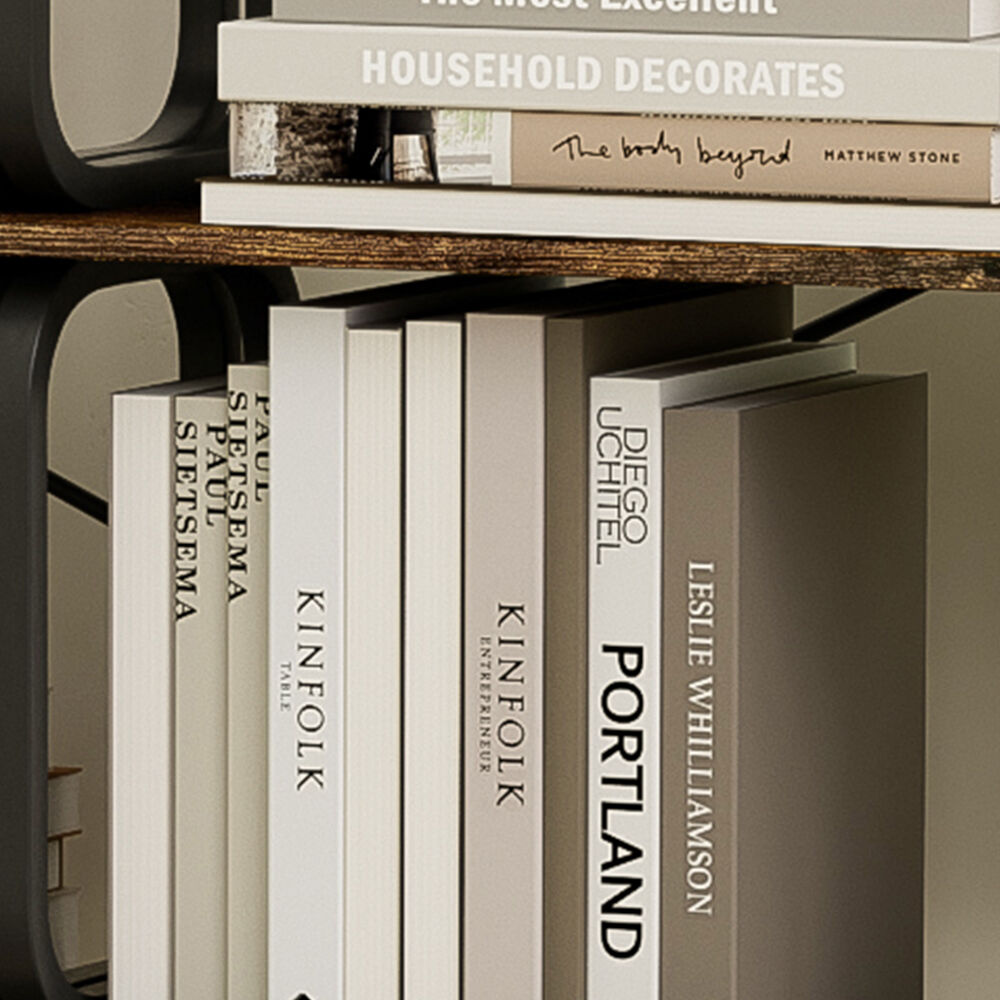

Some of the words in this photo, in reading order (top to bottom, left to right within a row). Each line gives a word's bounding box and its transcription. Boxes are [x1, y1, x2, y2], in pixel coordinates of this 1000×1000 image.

[361, 50, 602, 91] HOUSEHOLD
[614, 56, 845, 98] DECORATES
[553, 134, 611, 160] The
[621, 131, 681, 164] body
[697, 137, 790, 179] beyond
[825, 149, 901, 162] MATTHEW
[908, 151, 960, 164] STONE
[205, 424, 227, 527] PAUL
[228, 390, 248, 602] SIETSEMA
[254, 393, 269, 502] PAUL
[596, 406, 623, 565] UCHITEL
[622, 427, 648, 545] DIEGO
[175, 420, 198, 622] SIETSEMA
[688, 562, 714, 667] LESLIE
[280, 662, 292, 711] TABLE
[296, 590, 325, 792] KINFOLK
[479, 636, 492, 773] ENTREPRENEUR
[496, 603, 526, 807] KINFOLK
[600, 644, 644, 960] PORTLAND
[686, 676, 713, 916] WHILLIAMSON
